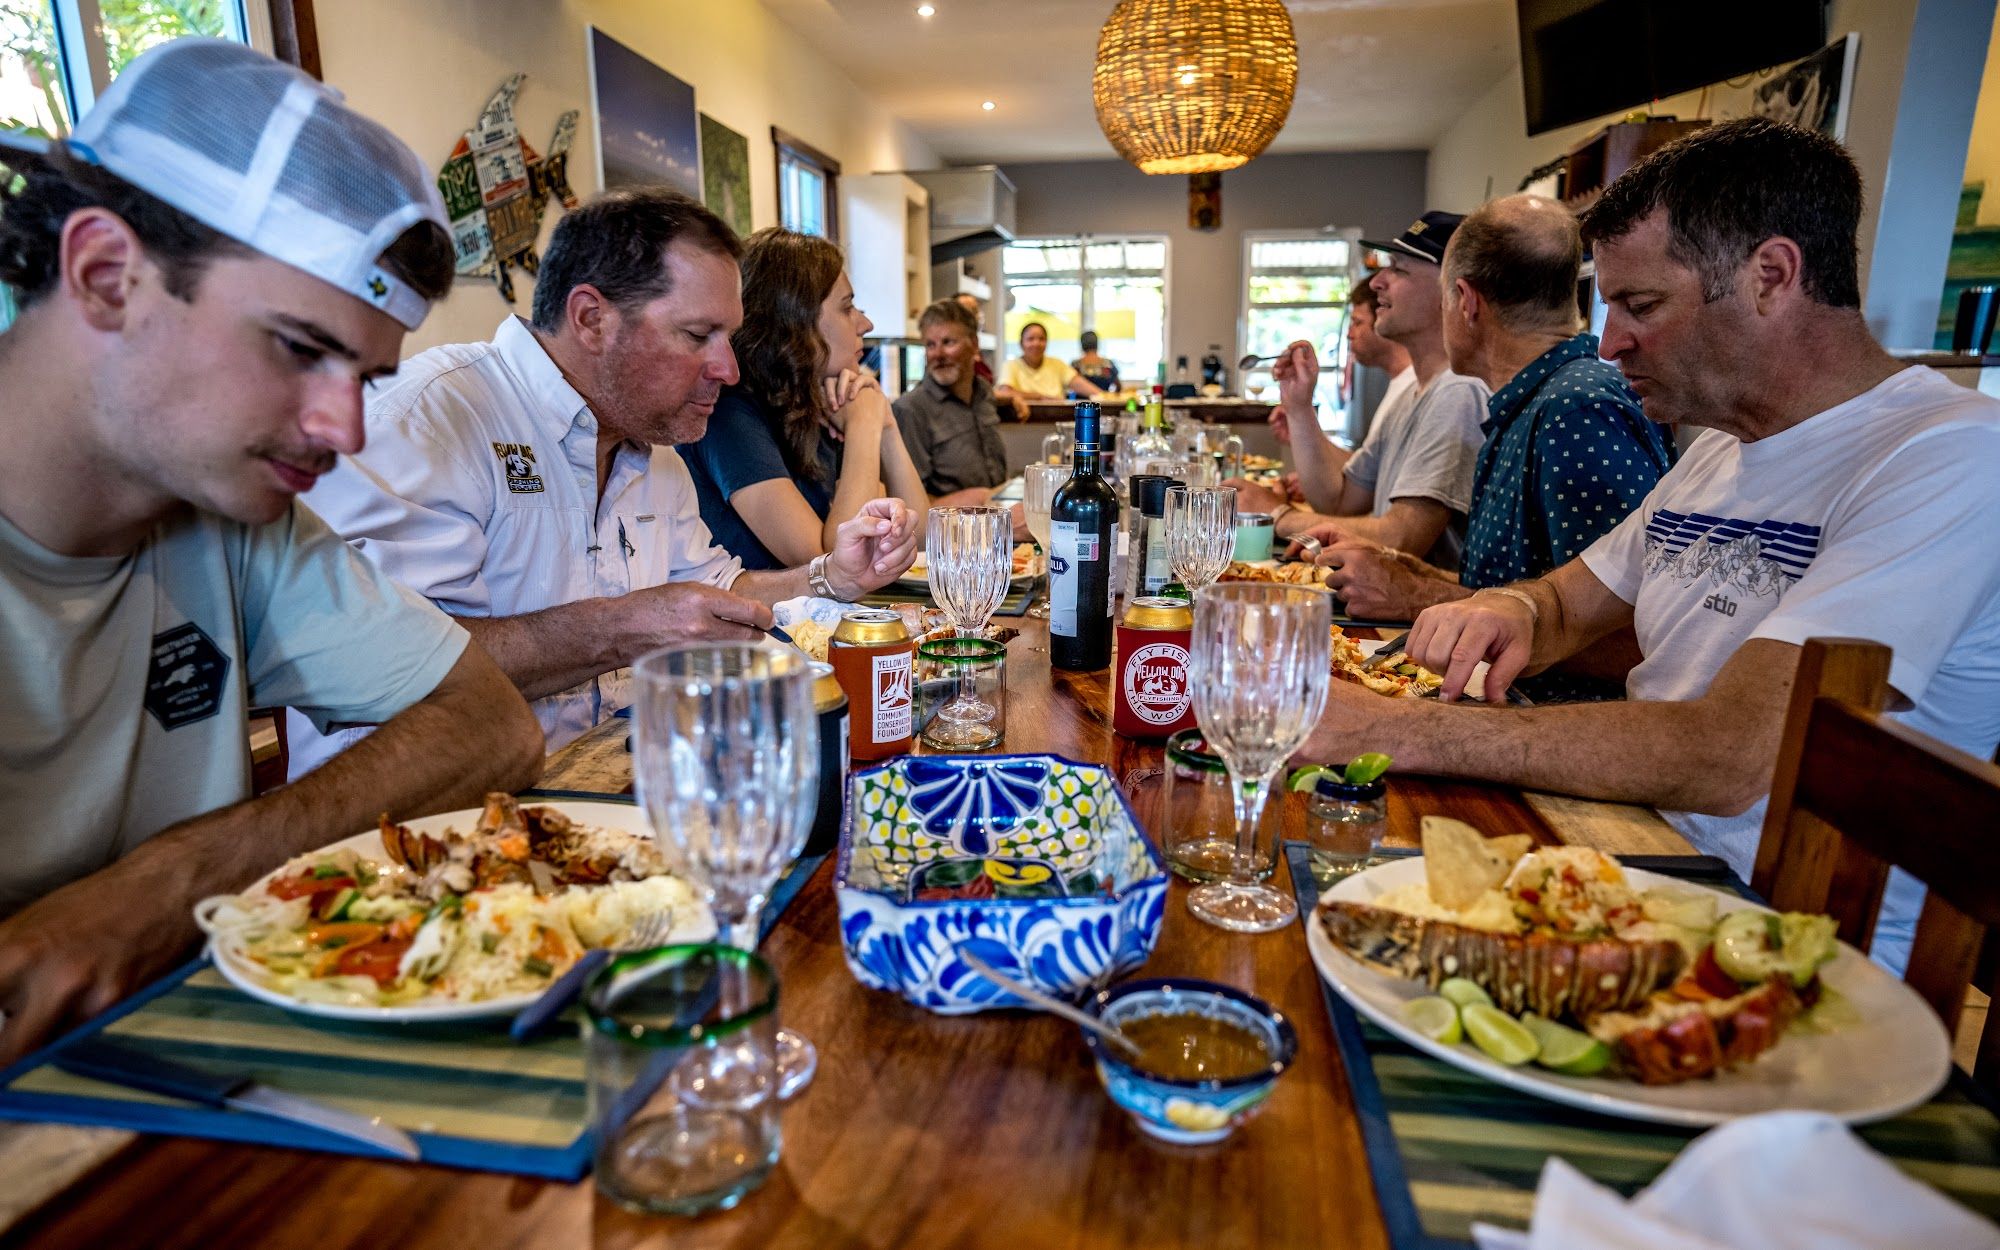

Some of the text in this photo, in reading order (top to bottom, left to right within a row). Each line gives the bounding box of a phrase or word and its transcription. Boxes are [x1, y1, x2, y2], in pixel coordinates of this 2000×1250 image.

[1703, 593, 1738, 617] stio
[877, 659, 901, 669] YELLOW
[1131, 647, 1191, 669] FLY FISH
[1136, 664, 1185, 682] YELLOW DOG
[1128, 689, 1145, 714] THE
[877, 709, 907, 721] COMMUNITY
[877, 725, 911, 738] FOUNDATION
